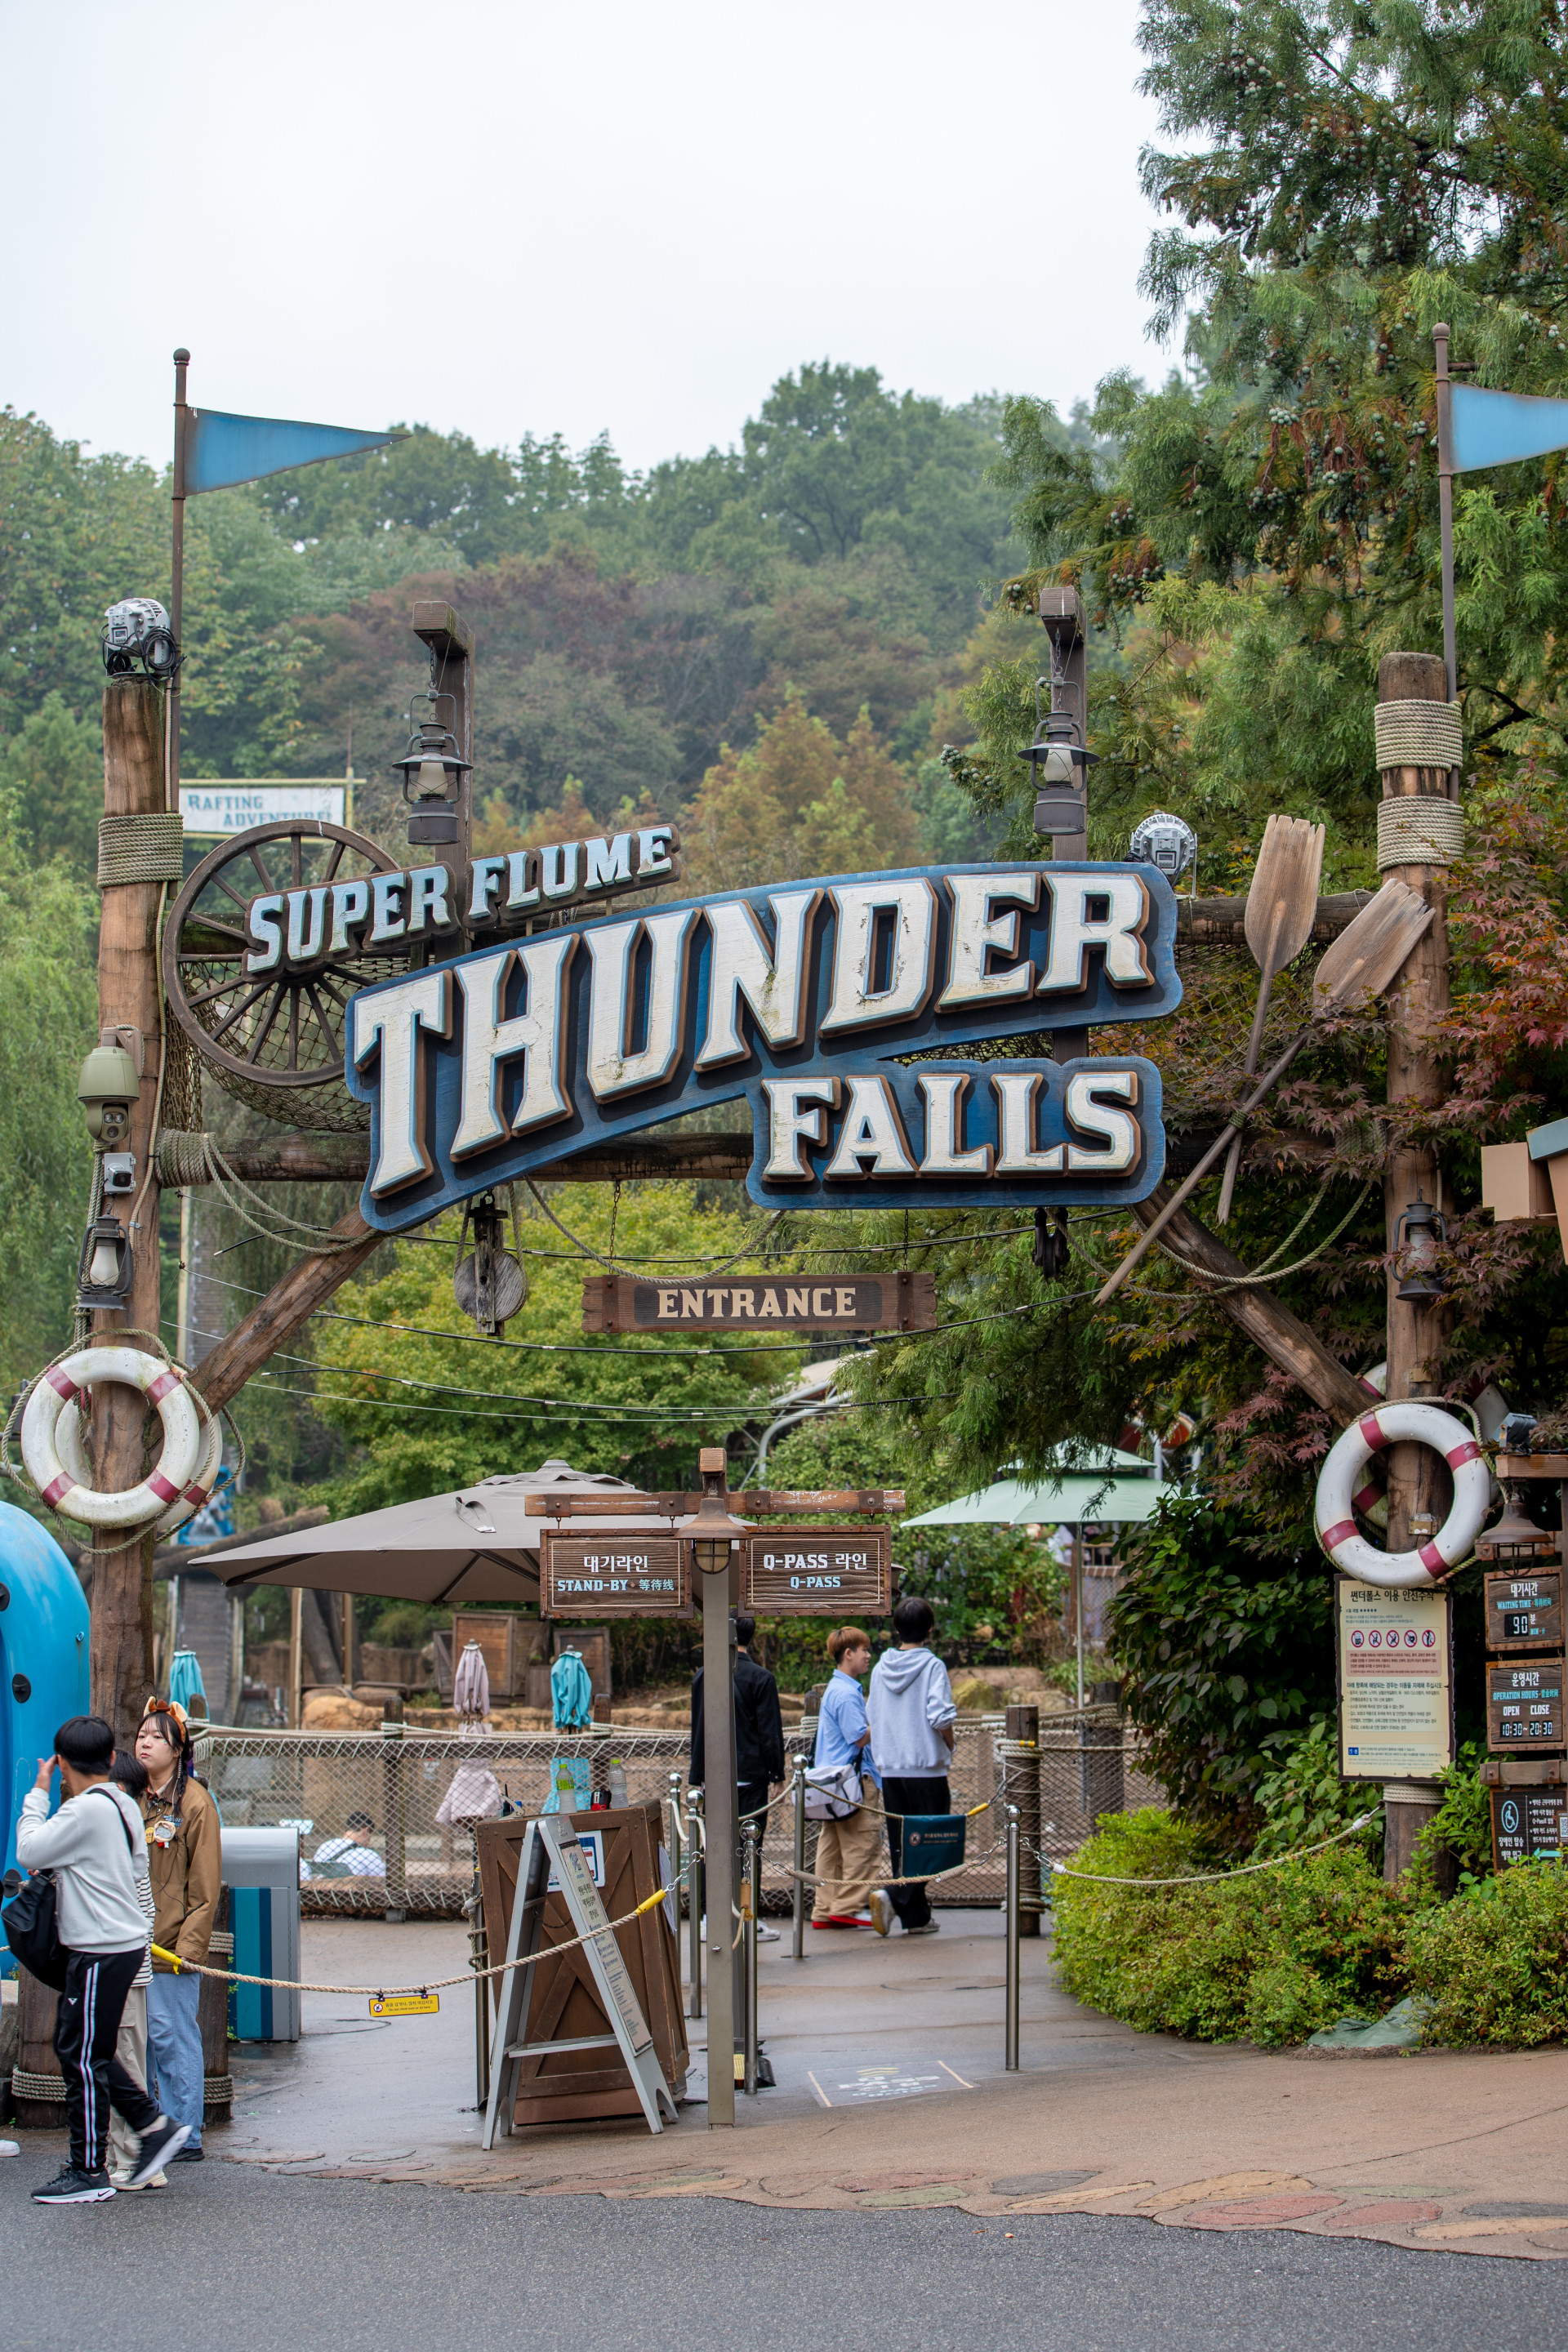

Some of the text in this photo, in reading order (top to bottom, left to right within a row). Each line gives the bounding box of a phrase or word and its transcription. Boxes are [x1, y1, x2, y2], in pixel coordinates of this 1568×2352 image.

[188, 795, 263, 810] RAFTING
[247, 826, 673, 973] SUPER FLUME
[353, 871, 1155, 1200] THUNDER
[761, 1071, 1141, 1183] FALLS
[657, 1287, 856, 1318] ENTRANCE
[583, 1555, 648, 1573] 대기라인
[764, 1552, 867, 1570] Q-PASS 라인
[557, 1579, 675, 1592] STAND-BY 等待线
[790, 1576, 841, 1589] Q-PASS
[1510, 1581, 1539, 1597] 대기시간
[1351, 1590, 1382, 1602] 썬더폴스
[1383, 1590, 1401, 1602] 이용
[1497, 1601, 1519, 1610] WAITING
[1519, 1600, 1532, 1608] TIME
[1513, 1615, 1528, 1634] 90
[1530, 1613, 1536, 1624] 분
[1512, 1672, 1540, 1687] 운영시간
[1493, 1690, 1521, 1700] OPERATION
[1521, 1690, 1539, 1699] HOURS
[1503, 1704, 1550, 1716] OPEN CLOSE
[1530, 1722, 1552, 1735] 20:30
[1498, 1837, 1525, 1847] 장애인 탑승
